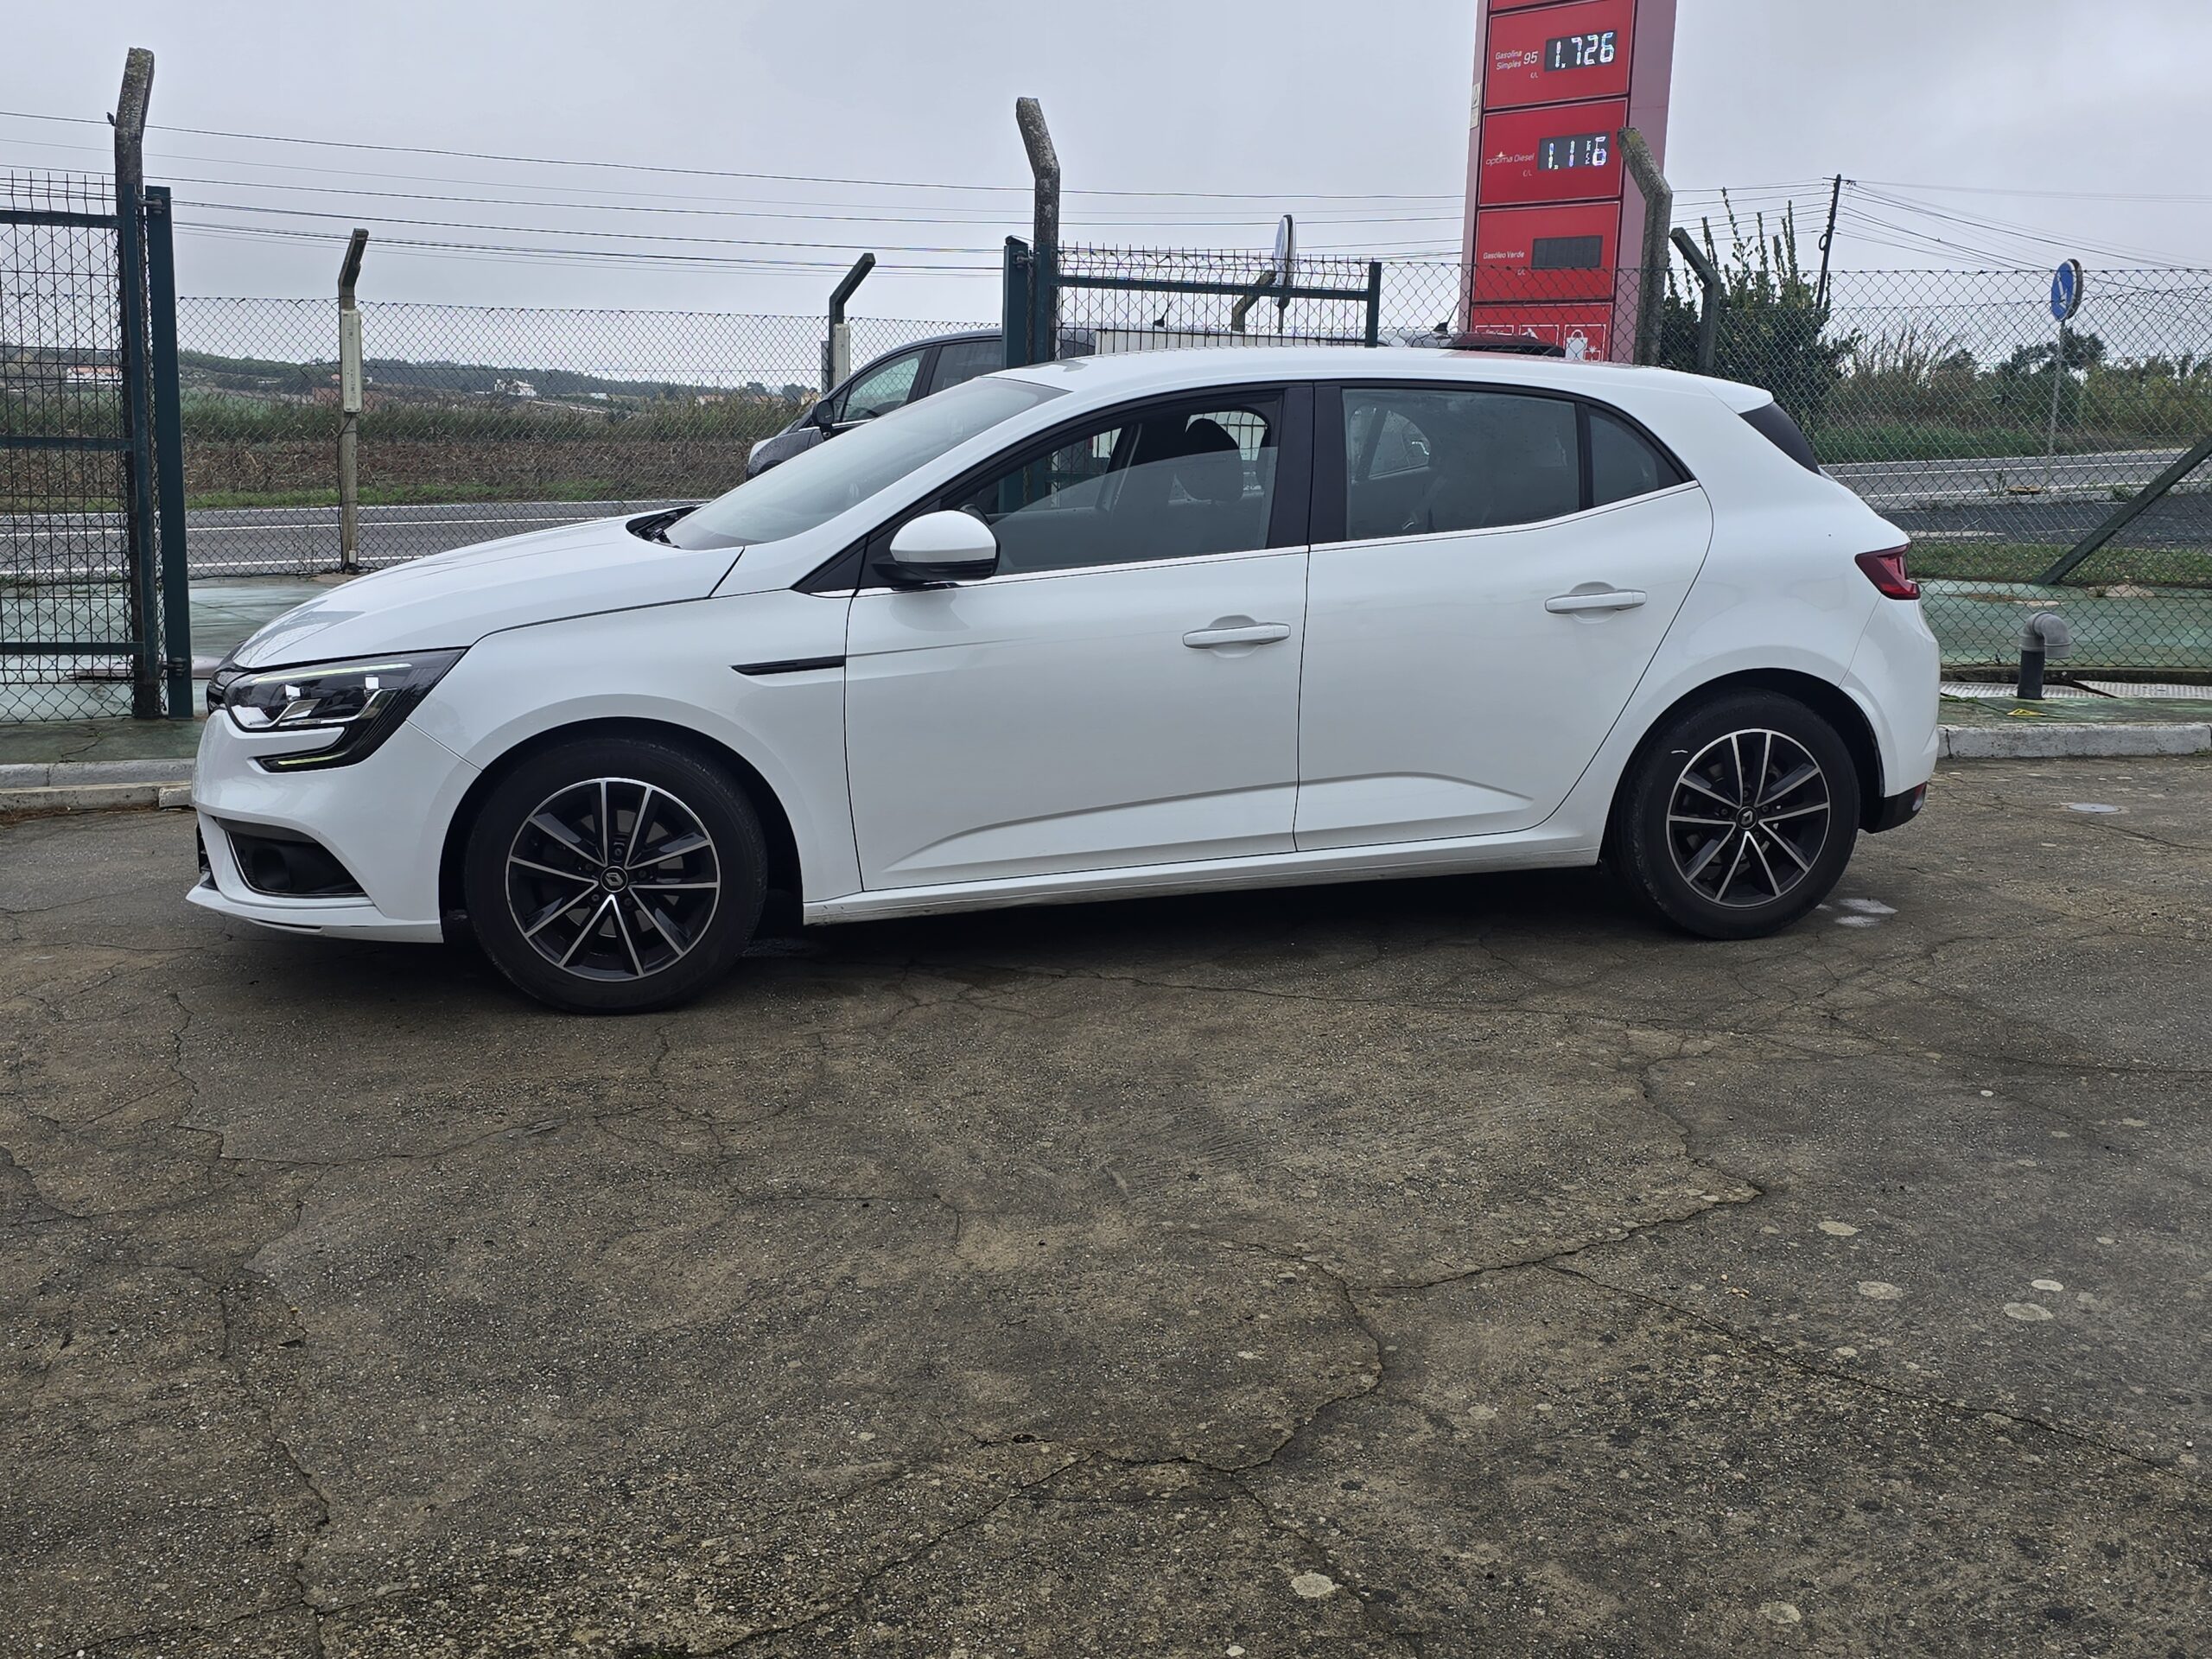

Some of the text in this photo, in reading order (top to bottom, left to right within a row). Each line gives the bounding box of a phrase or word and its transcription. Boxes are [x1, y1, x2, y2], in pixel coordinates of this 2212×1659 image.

[1496, 50, 1522, 60] Gasolina
[1554, 32, 1615, 68] 1.726
[1523, 51, 1538, 65] 95
[1497, 60, 1521, 70] Simples
[1514, 153, 1535, 162] Diesel
